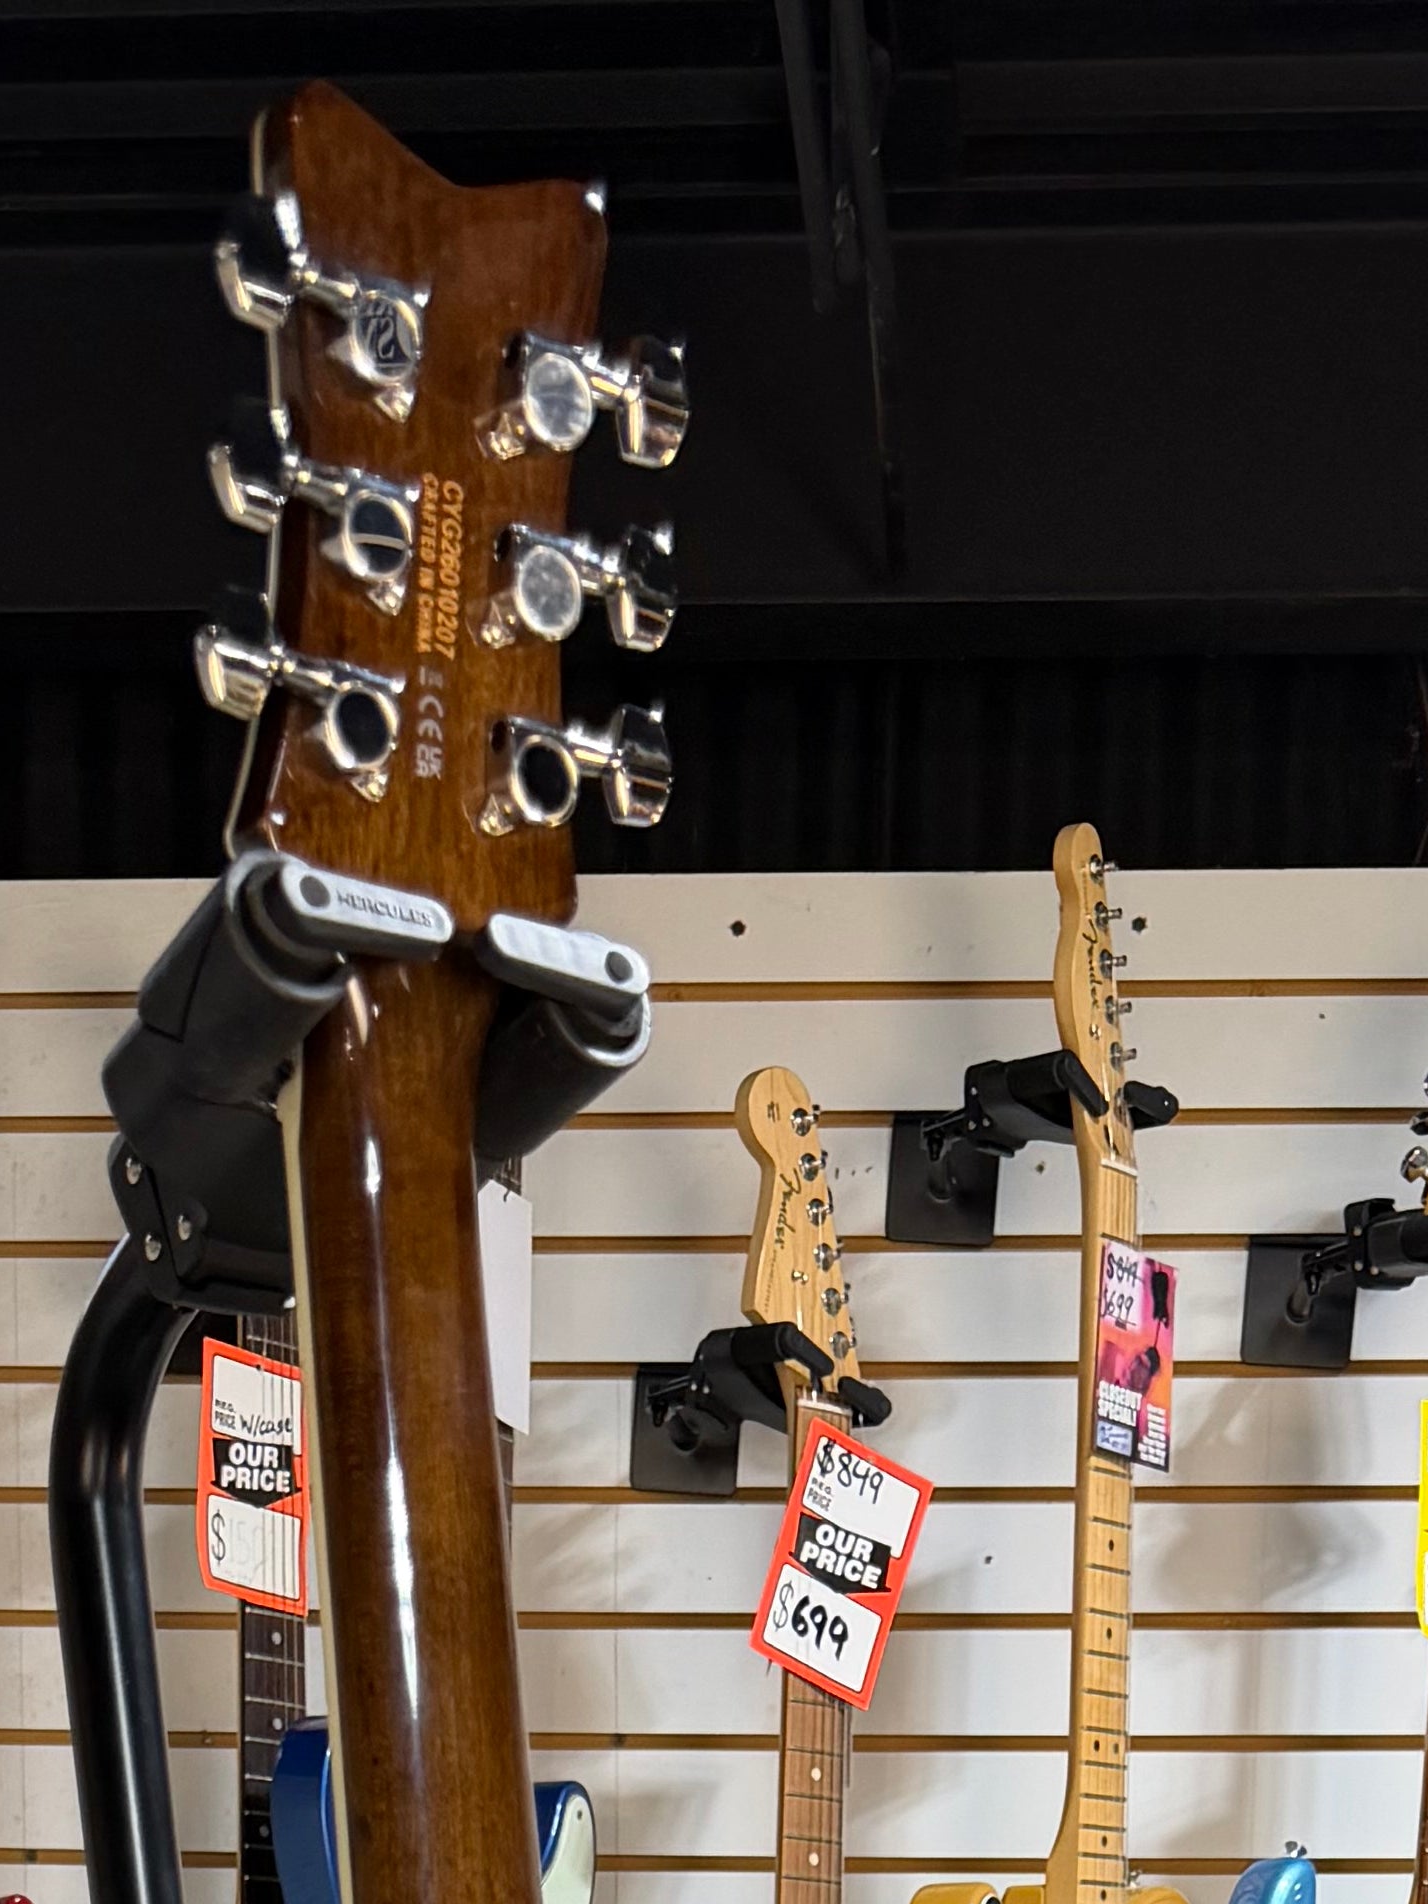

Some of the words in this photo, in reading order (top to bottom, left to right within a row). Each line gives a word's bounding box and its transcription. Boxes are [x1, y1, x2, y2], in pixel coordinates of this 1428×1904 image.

[335, 889, 433, 929] HERCULES
[775, 1168, 802, 1251] Fender
[229, 1442, 279, 1469] OUR
[816, 1436, 885, 1505] $849
[220, 1464, 291, 1494] PRICE
[815, 1523, 874, 1563] OUR
[799, 1541, 882, 1590] PRICE
[772, 1579, 849, 1662] $699
